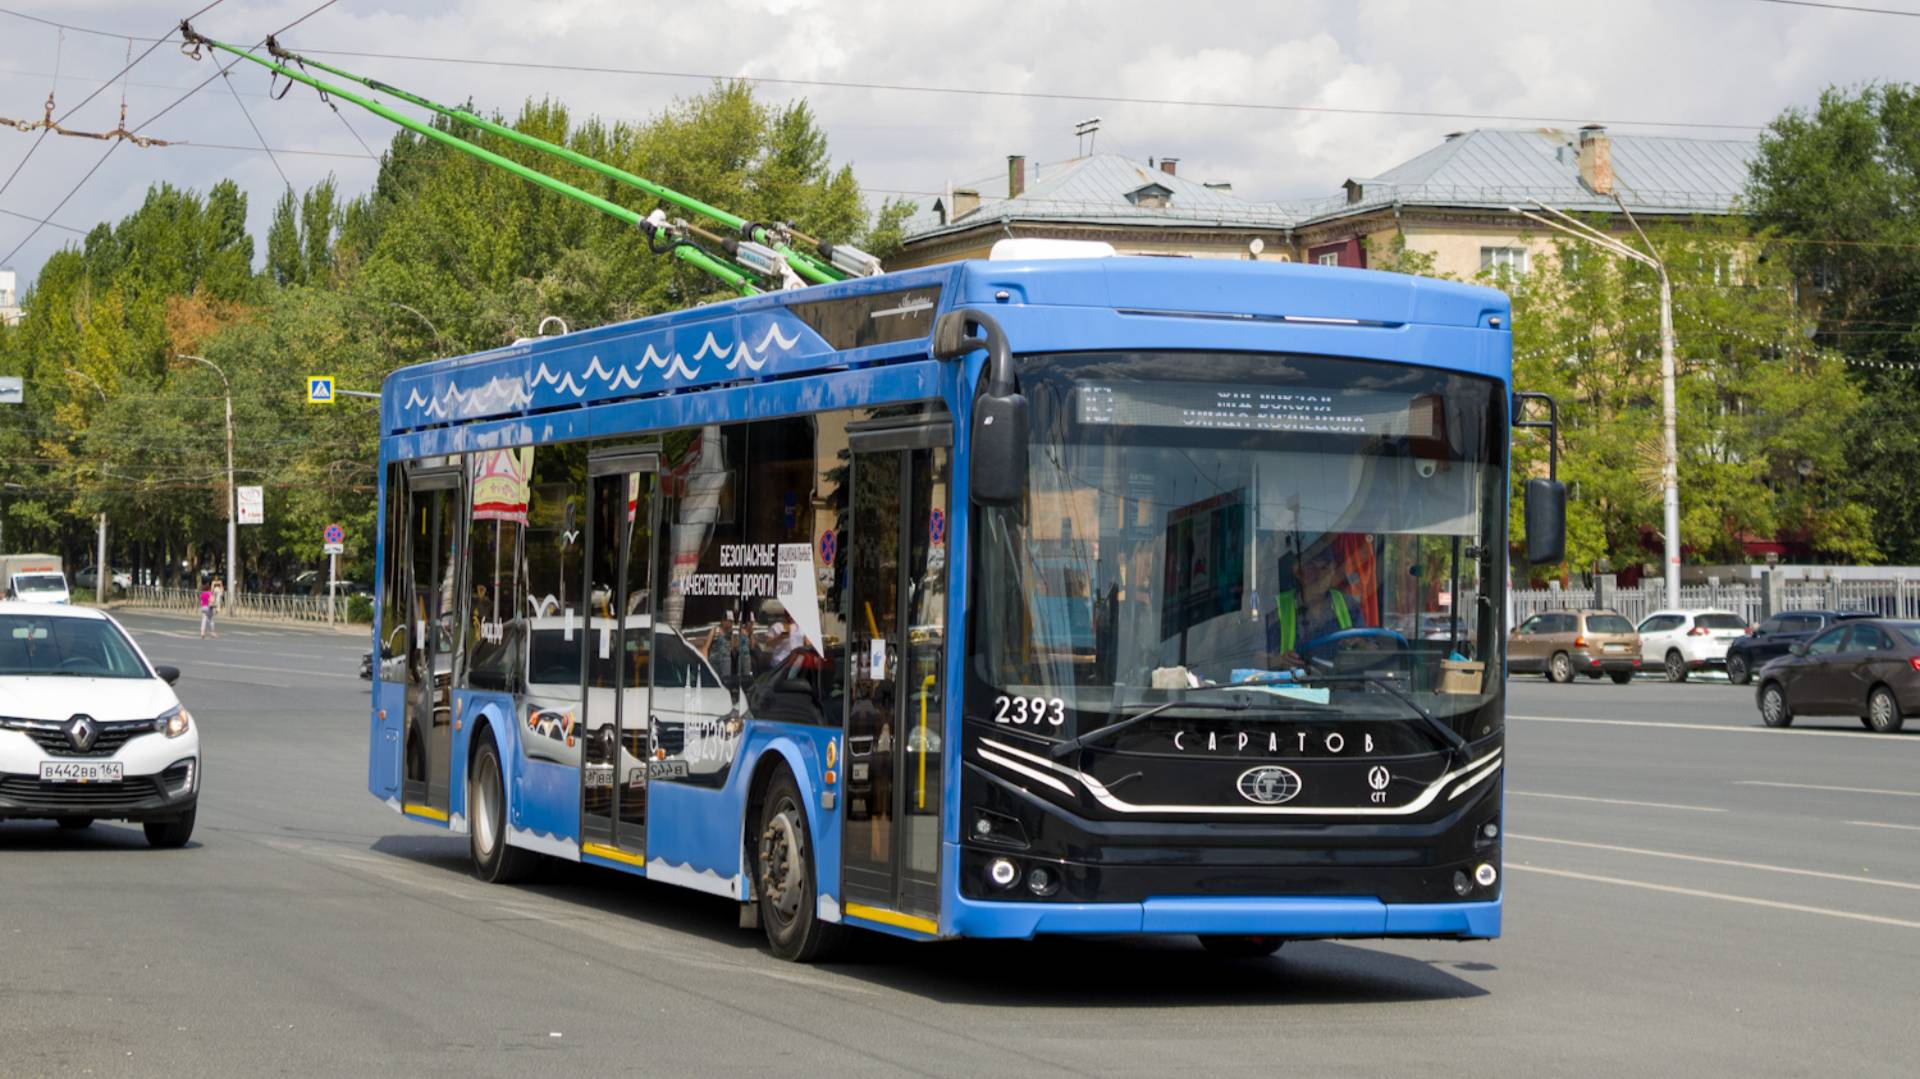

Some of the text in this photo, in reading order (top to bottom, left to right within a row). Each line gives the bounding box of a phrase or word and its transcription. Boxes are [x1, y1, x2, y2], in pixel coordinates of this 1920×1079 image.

[720, 544, 775, 567] БЕЗОПАСНЫЕ
[680, 573, 775, 600] КАЧЕСТВЕННЫЕ ДОРОГИ
[994, 695, 1065, 726] 2393
[1174, 731, 1374, 753] САРАТОВ
[100, 764, 119, 775] 164
